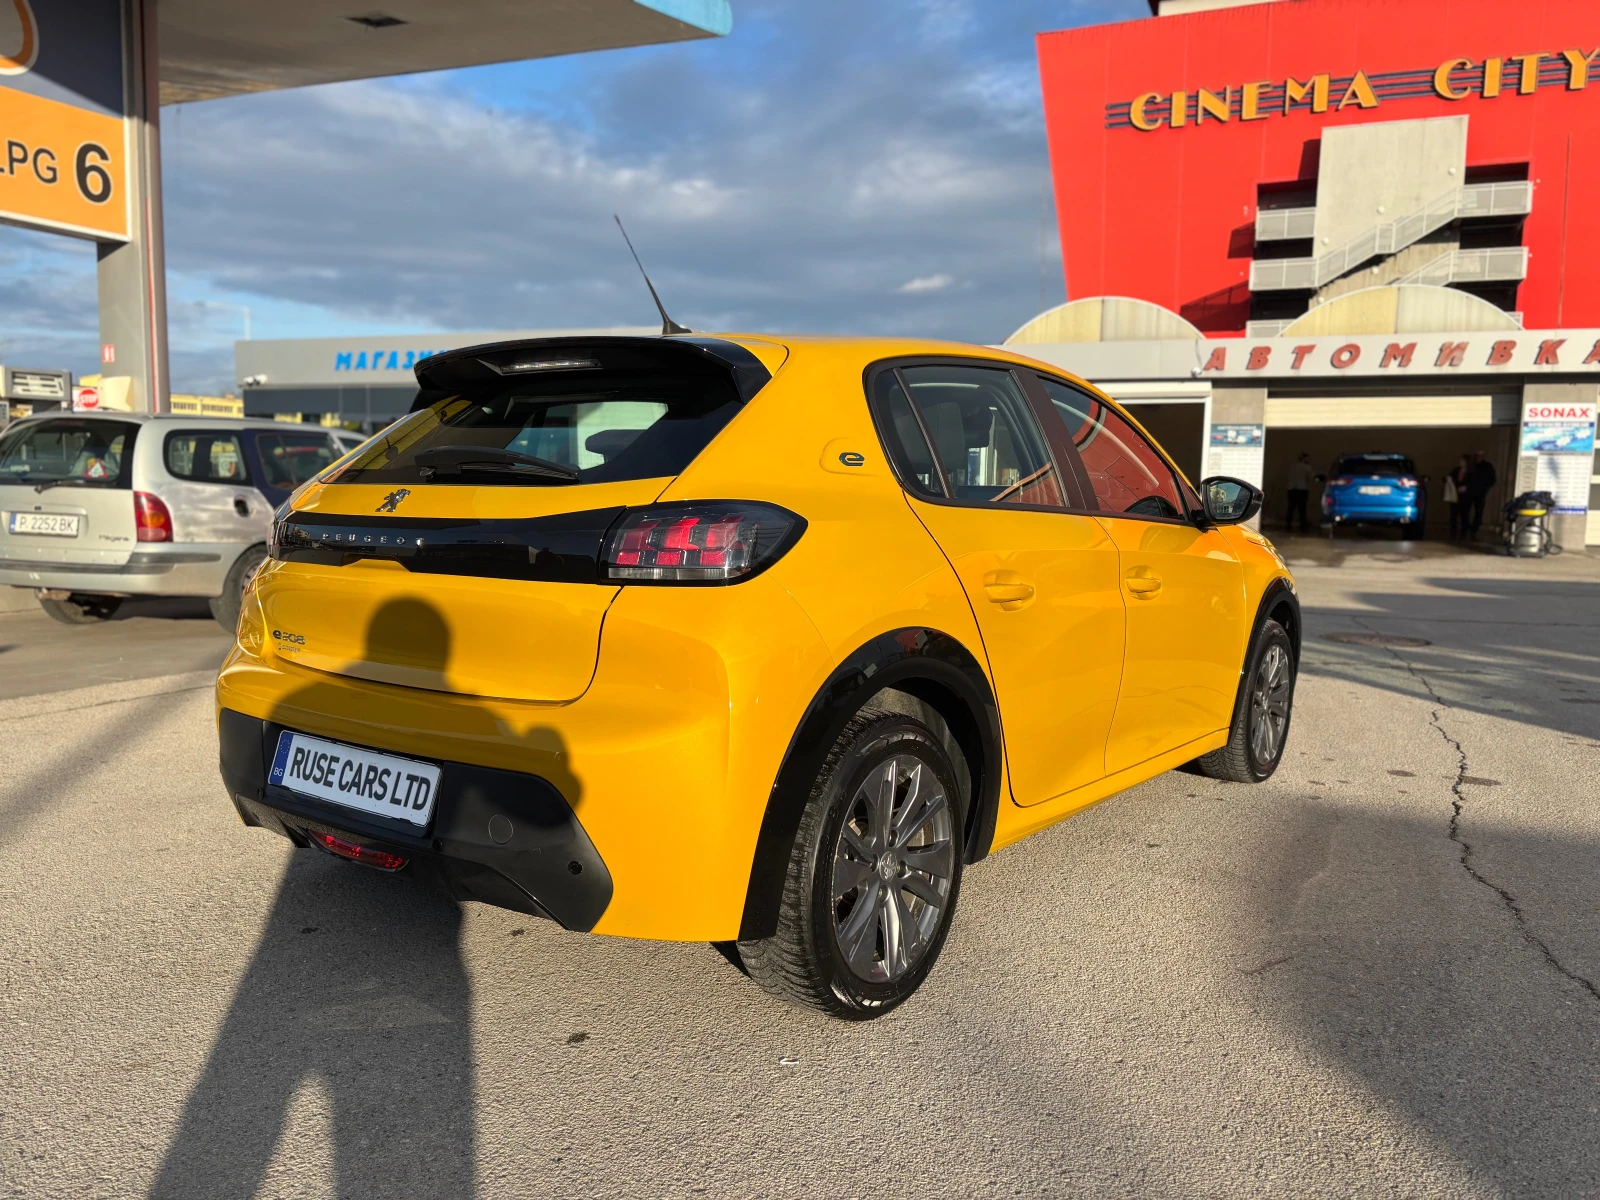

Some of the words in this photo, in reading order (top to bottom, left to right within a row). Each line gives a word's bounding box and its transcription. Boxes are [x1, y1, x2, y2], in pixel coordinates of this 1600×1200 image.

[1130, 70, 1379, 130] CINEMA
[1433, 47, 1600, 101] CITY
[0, 139, 58, 184] PG
[75, 142, 112, 204] 6
[334, 350, 453, 371] МАГАЗ
[1203, 338, 1600, 371] АВТОМИВКА
[1528, 407, 1589, 418] SONAX
[322, 533, 424, 546] PEUGEOT
[273, 767, 283, 777] BG
[289, 746, 340, 788] RUSE
[338, 759, 391, 801] CARS
[389, 771, 431, 811] LTD
